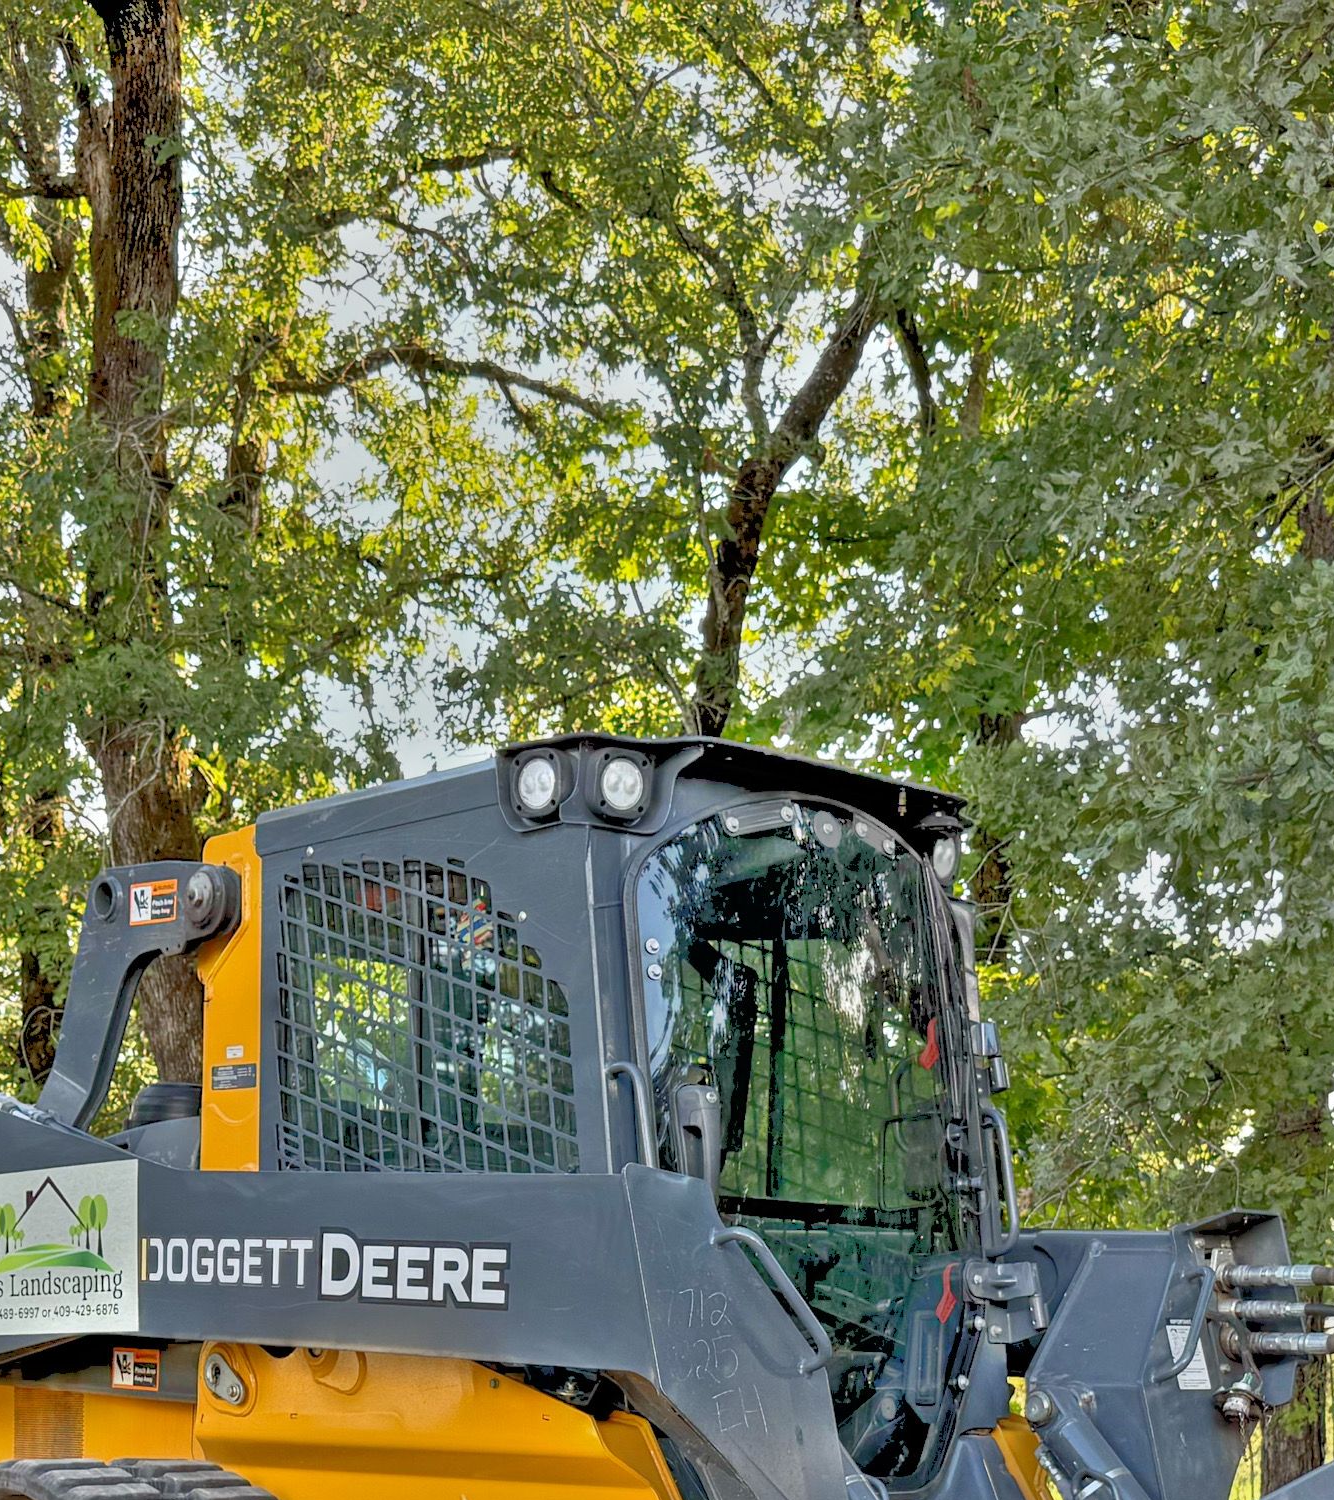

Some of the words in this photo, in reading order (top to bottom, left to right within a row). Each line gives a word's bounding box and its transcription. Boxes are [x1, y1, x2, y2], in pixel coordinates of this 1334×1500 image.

[10, 1267, 124, 1301] Landscaping
[142, 1237, 313, 1287] DOGGETT
[321, 1232, 508, 1305] DEERE
[41, 1309, 52, 1318] or
[53, 1303, 120, 1317] 409-429-6876
